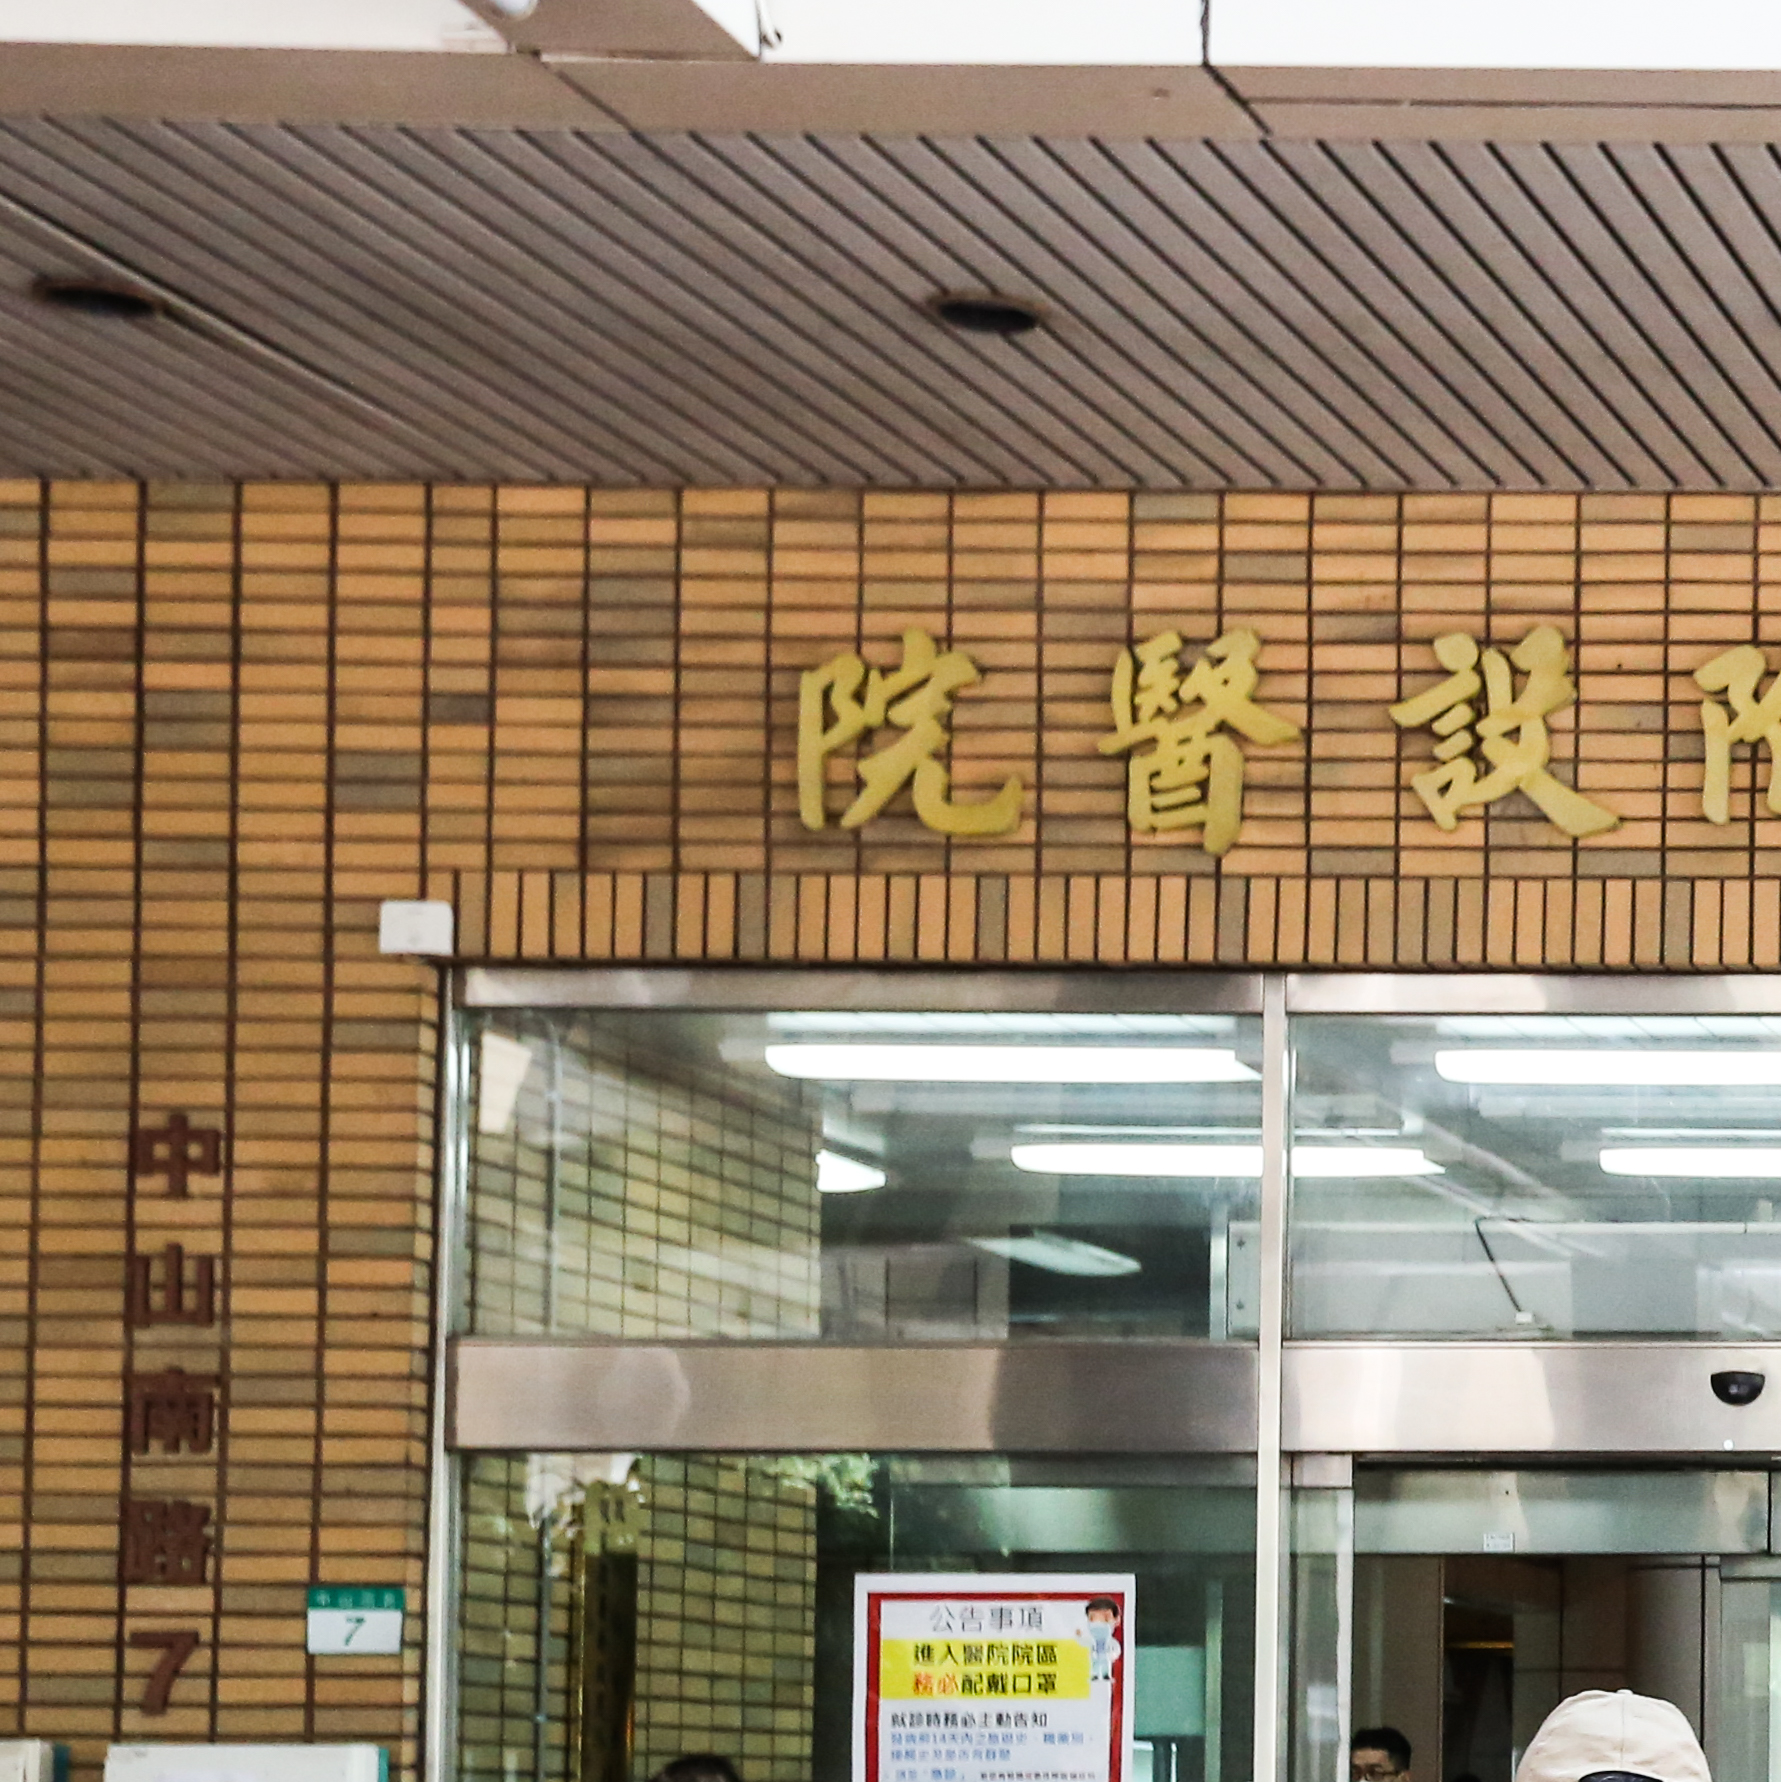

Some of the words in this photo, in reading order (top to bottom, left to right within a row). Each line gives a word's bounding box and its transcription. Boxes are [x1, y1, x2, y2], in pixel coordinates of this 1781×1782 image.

[344, 1615, 364, 1647] 7
[931, 1605, 1044, 1633] 公告事項
[914, 1643, 1058, 1666] 進入醫院院區
